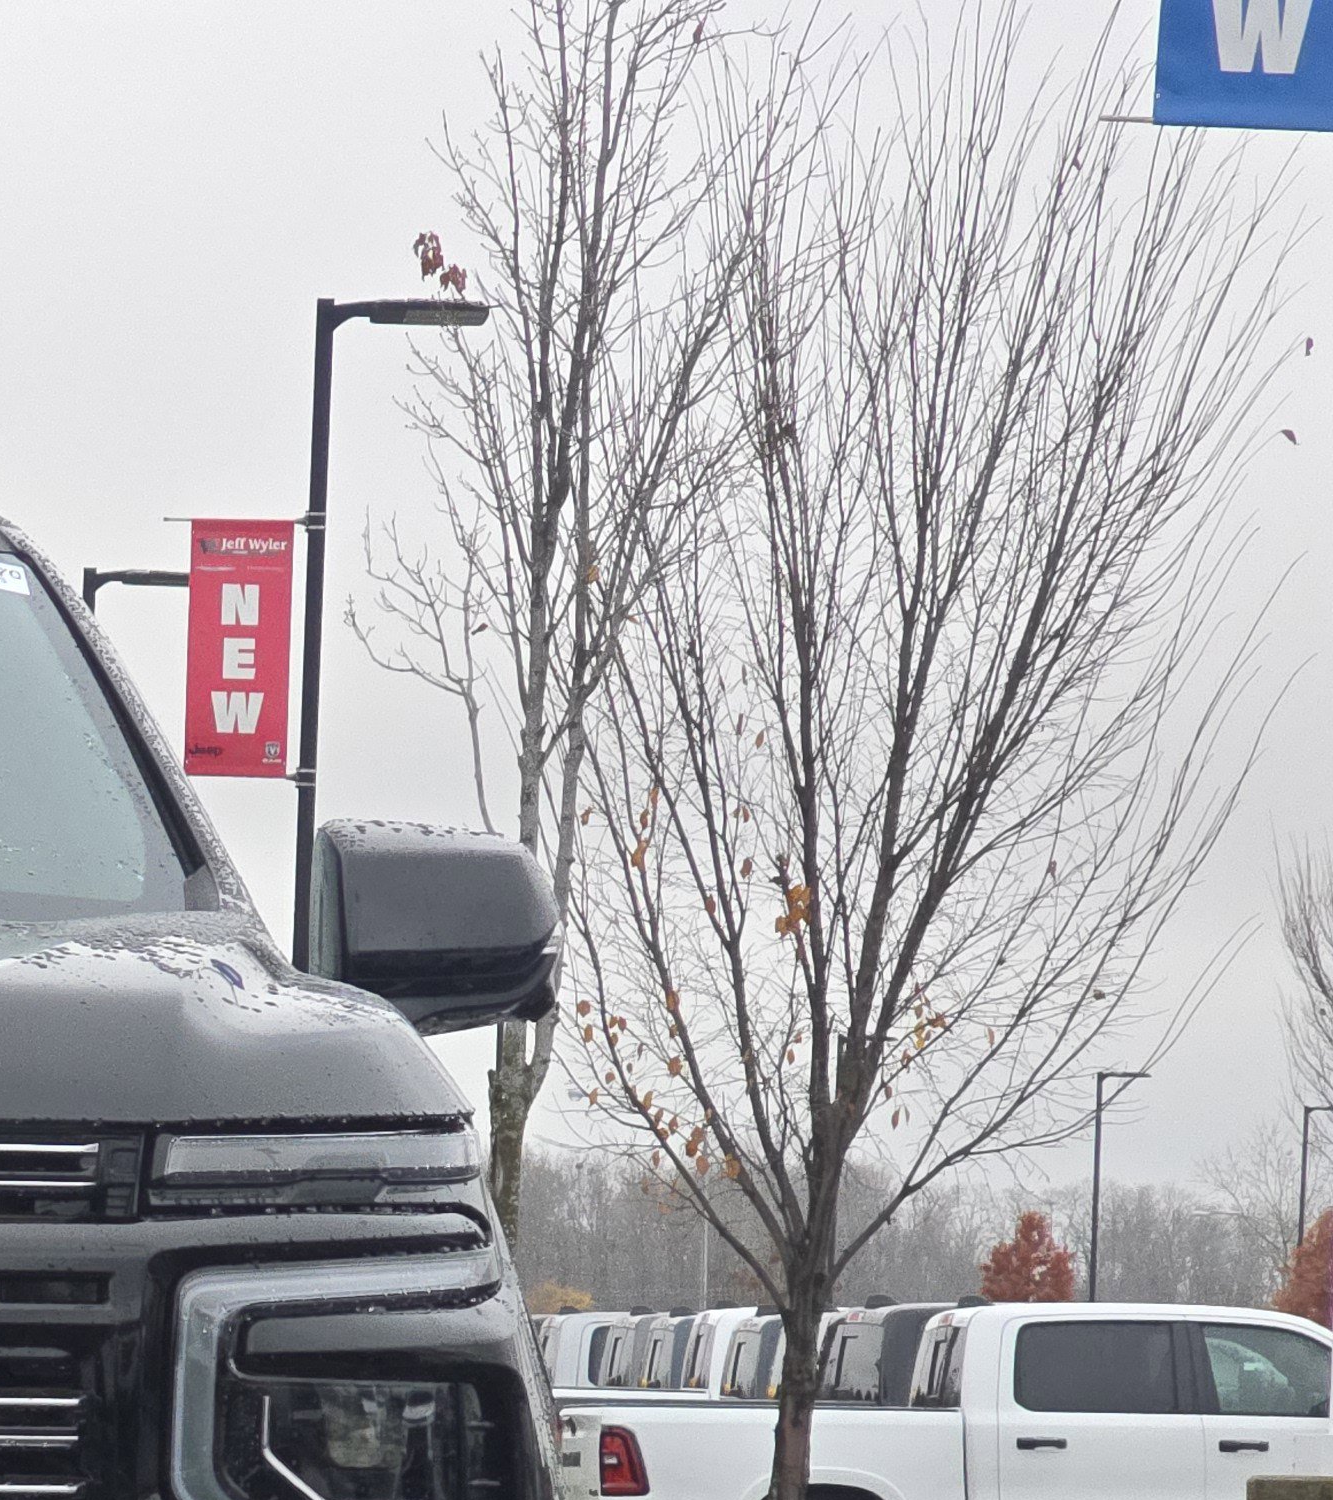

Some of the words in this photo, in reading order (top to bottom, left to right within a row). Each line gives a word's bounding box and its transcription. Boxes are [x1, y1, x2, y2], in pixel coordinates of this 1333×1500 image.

[221, 537, 246, 551] Jeff
[248, 538, 287, 554] Wyler
[210, 583, 265, 734] NEW
